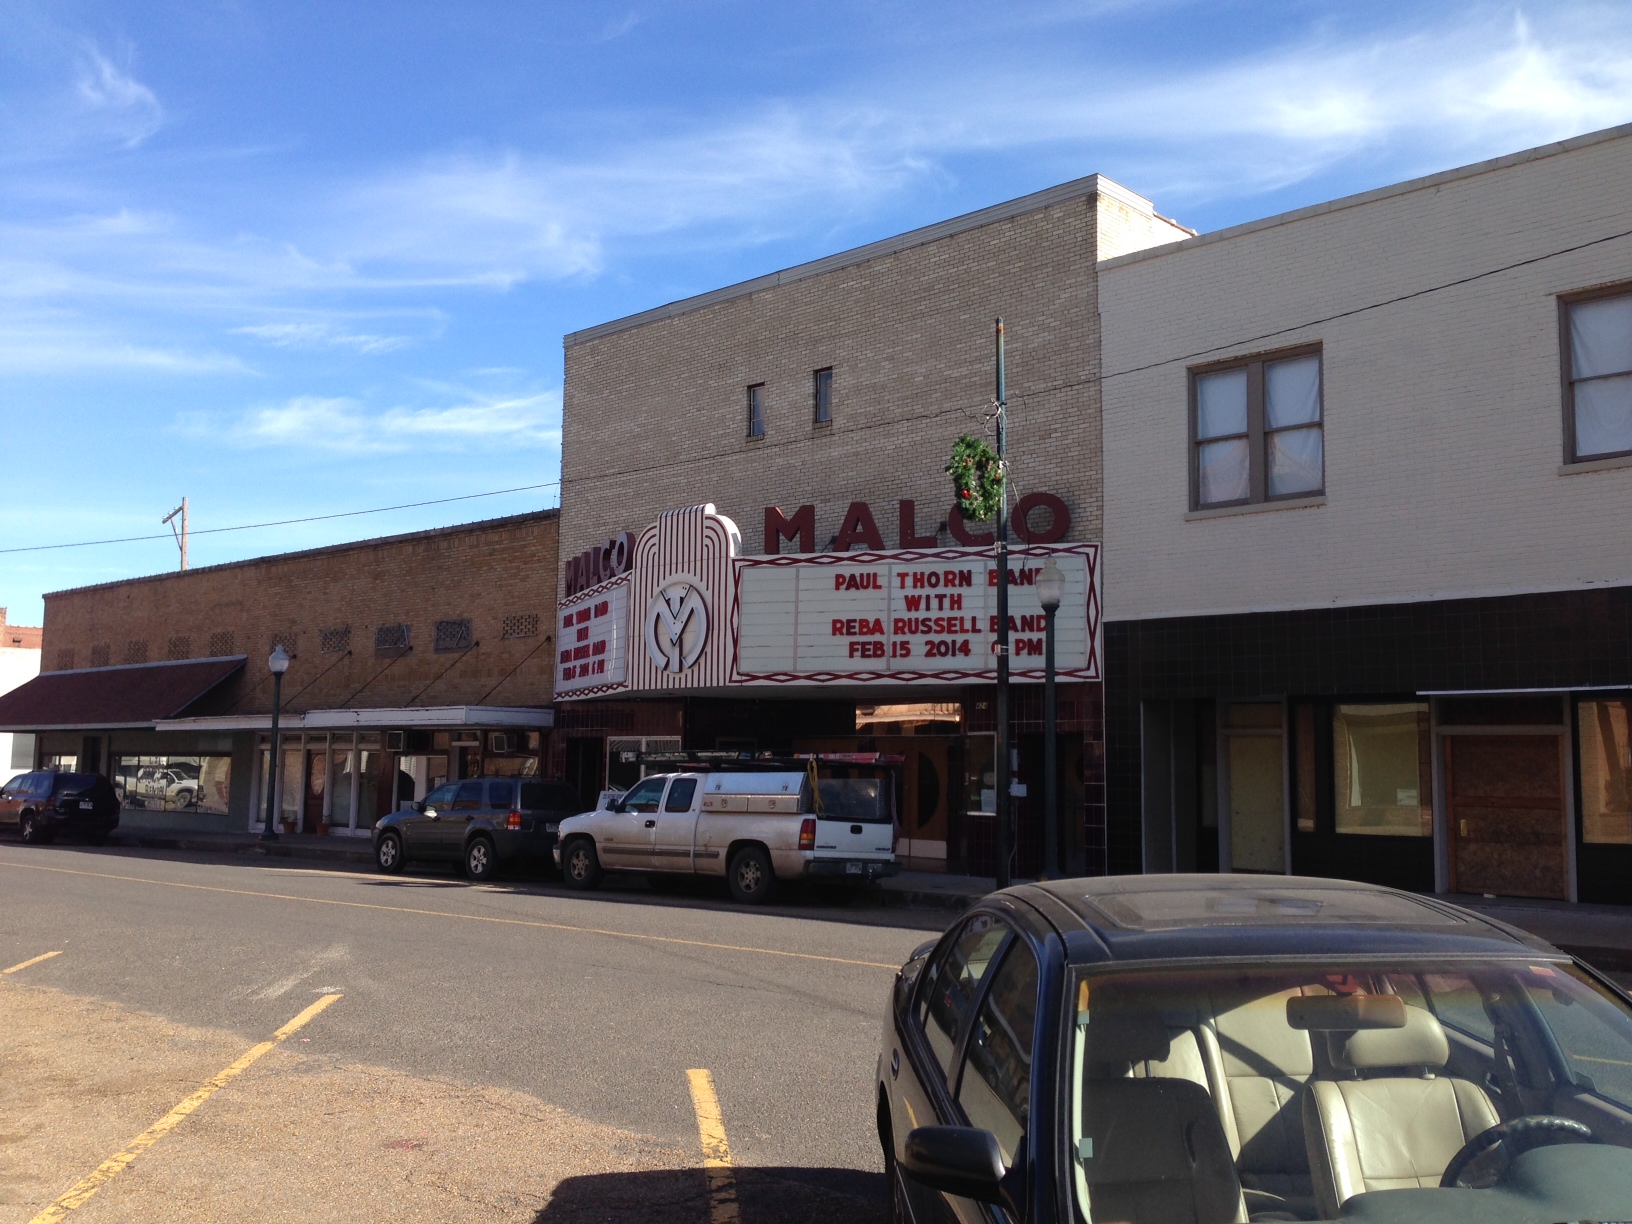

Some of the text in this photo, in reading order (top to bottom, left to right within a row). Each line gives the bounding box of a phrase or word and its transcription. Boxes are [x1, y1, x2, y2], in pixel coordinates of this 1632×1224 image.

[764, 492, 1071, 555] MALCO
[834, 572, 882, 591] PAUL
[897, 569, 972, 590] THORN
[904, 593, 963, 612] WITH
[831, 618, 885, 636] REBA
[893, 616, 982, 635] RUSSELL
[849, 640, 886, 659] FEB
[890, 640, 911, 658] 15
[924, 639, 971, 657] 2014
[1014, 638, 1043, 656] PM
